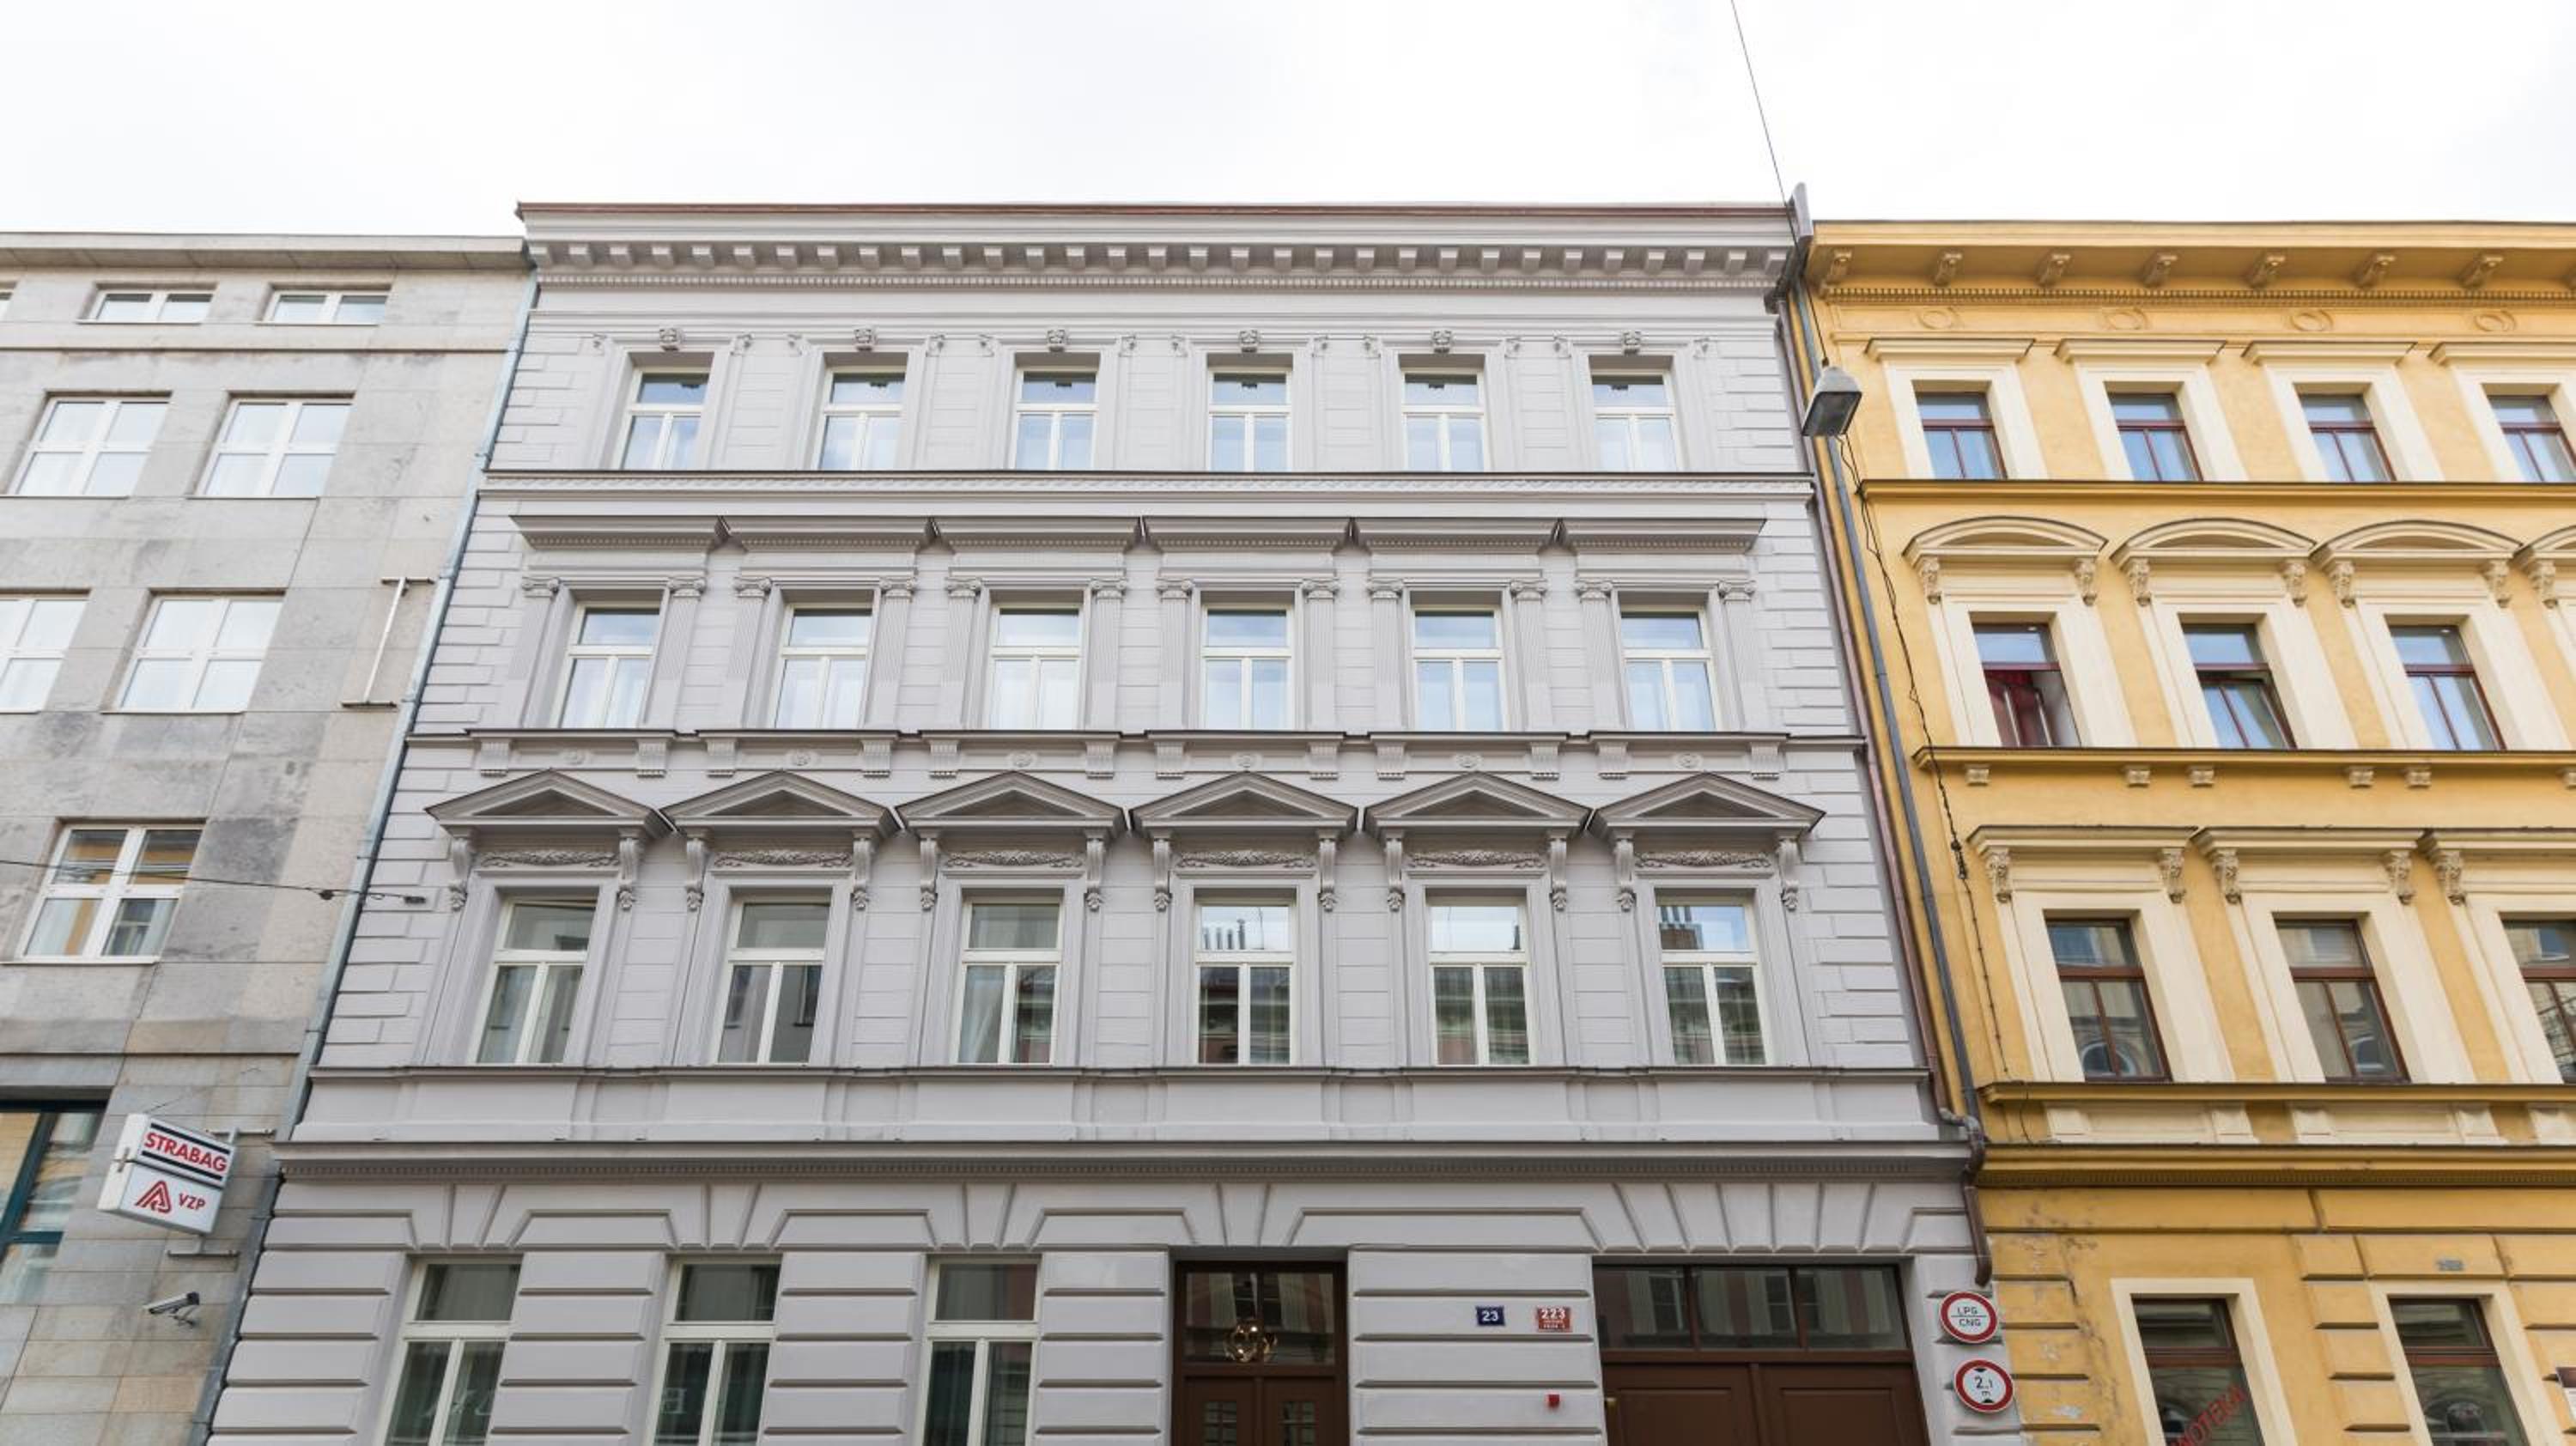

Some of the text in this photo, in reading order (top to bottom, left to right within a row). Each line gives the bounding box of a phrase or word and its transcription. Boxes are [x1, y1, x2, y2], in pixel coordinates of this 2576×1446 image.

[144, 1132, 228, 1172] STRABAG
[179, 1193, 206, 1210] VZP
[1481, 1310, 1499, 1321] 23
[1540, 1308, 1565, 1320] 223
[1957, 1305, 1978, 1315] LPG
[1959, 1318, 1982, 1327] CNG
